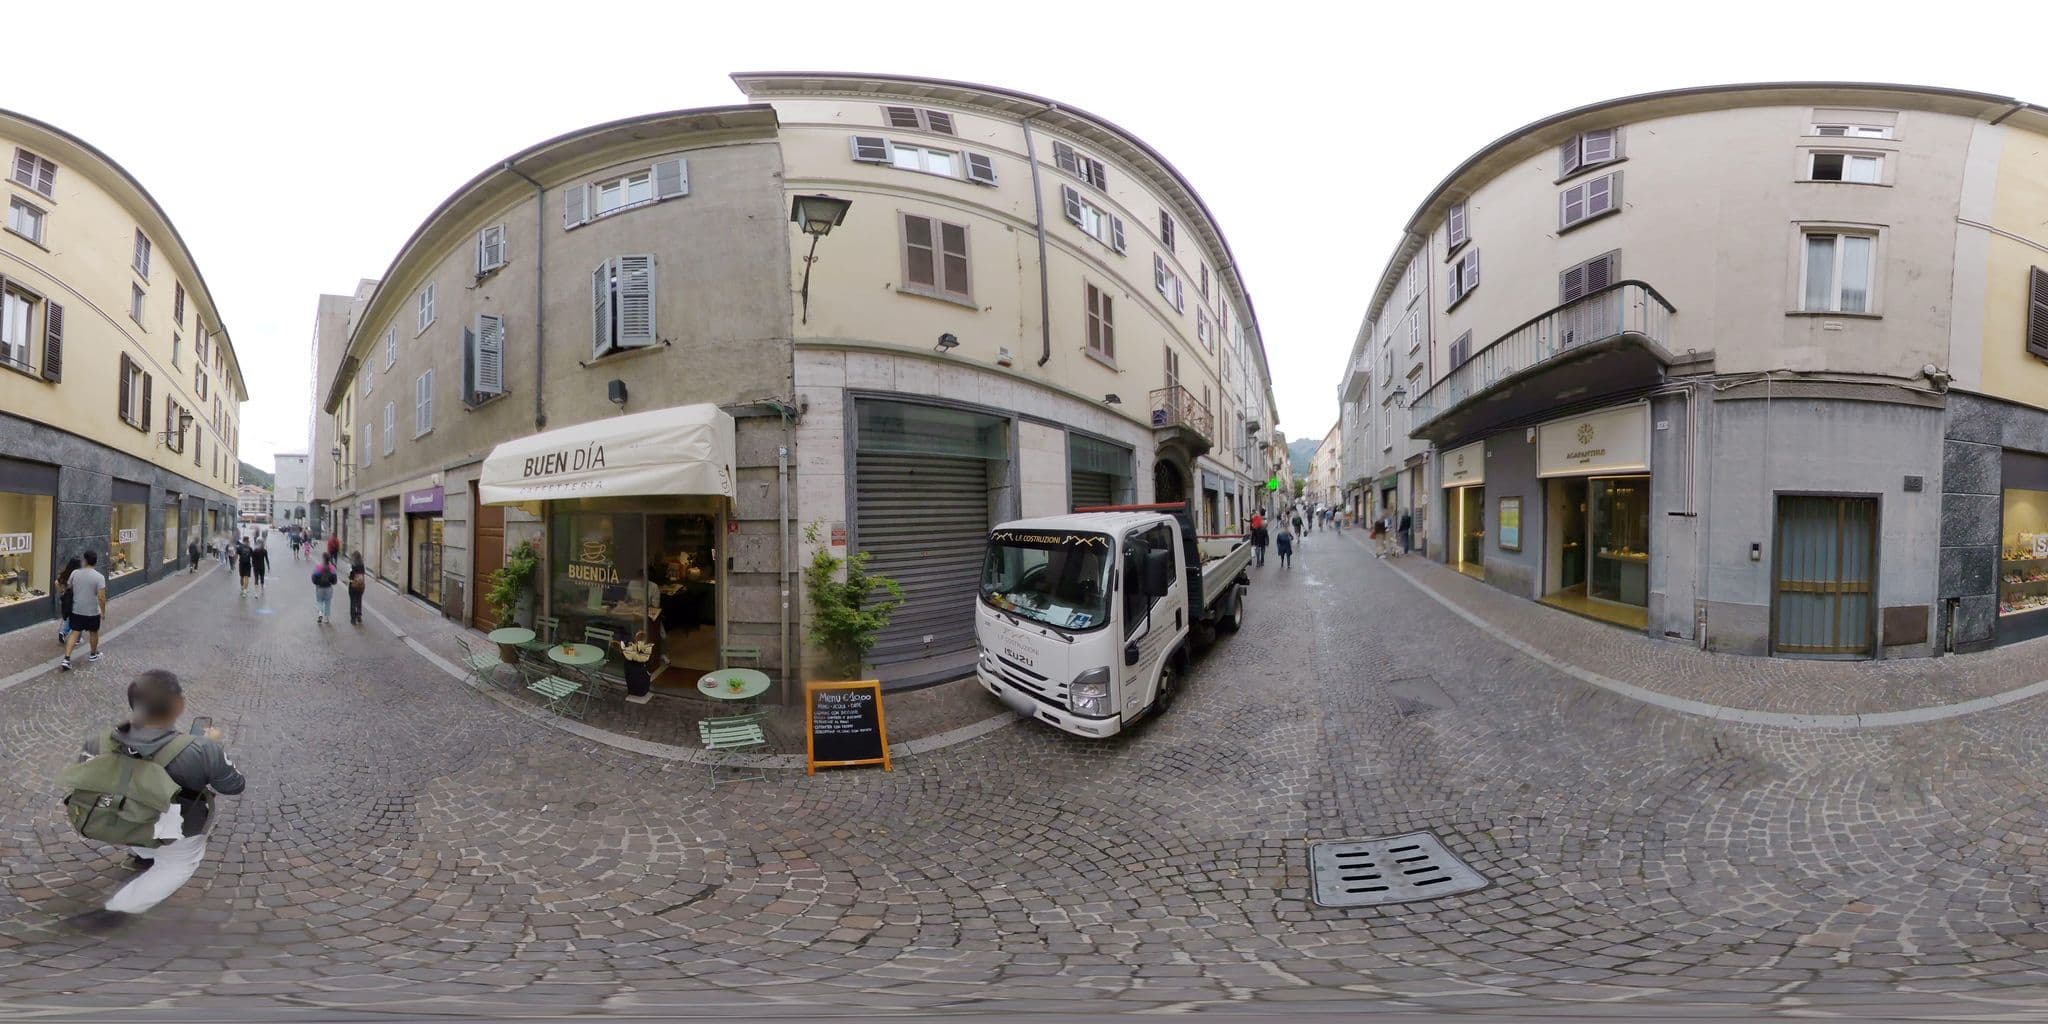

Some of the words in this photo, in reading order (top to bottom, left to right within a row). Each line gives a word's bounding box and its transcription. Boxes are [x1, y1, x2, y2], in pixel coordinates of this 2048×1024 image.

[523, 451, 568, 477] BUEN
[573, 441, 605, 471] DÍA
[760, 481, 769, 498] 7
[0, 536, 30, 551] ALDI
[1023, 535, 1061, 544] COSTRUZIONI
[1004, 647, 1033, 667] ISUZU
[819, 692, 841, 703] Menu
